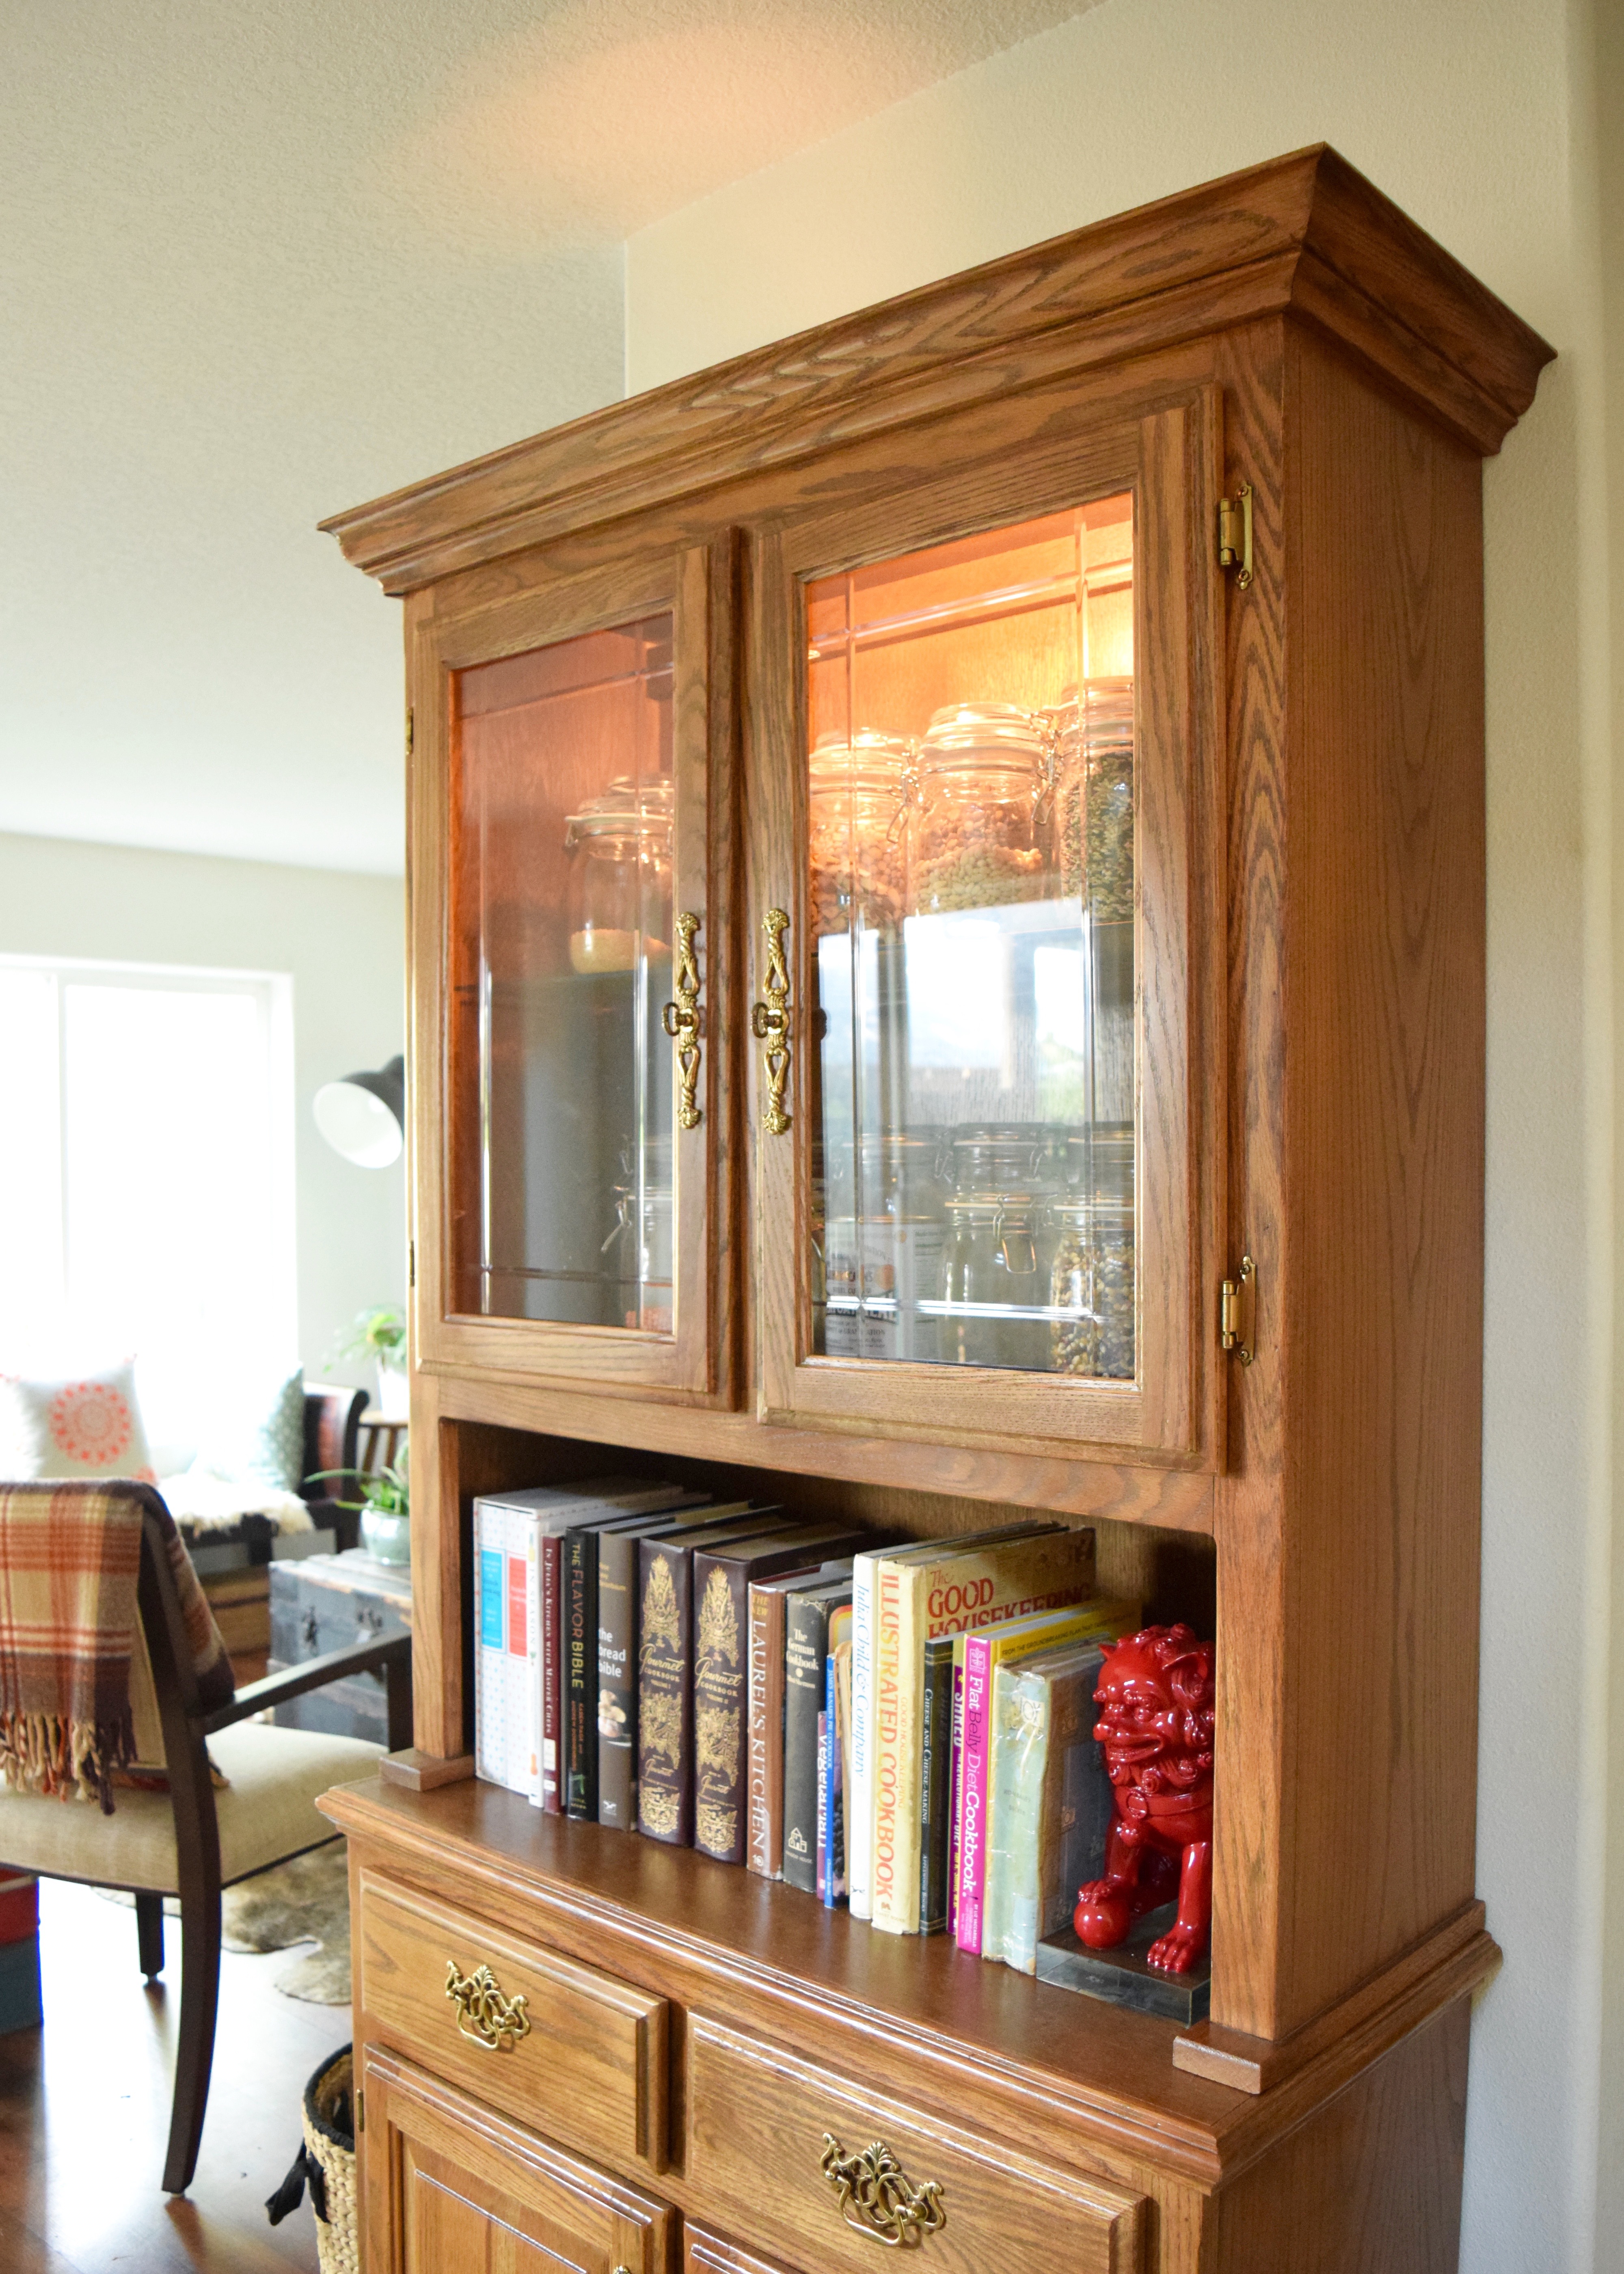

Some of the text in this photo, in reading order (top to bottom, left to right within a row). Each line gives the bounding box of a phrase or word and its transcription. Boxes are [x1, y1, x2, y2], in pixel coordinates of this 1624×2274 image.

[931, 1570, 954, 1587] The
[855, 1582, 870, 1624] Julia
[928, 1578, 994, 1618] GOOD
[929, 1585, 1092, 1639] HOUSEKEEPING
[571, 1543, 584, 1689] THE FLAVOR BIBLE
[598, 1627, 613, 1642] the
[787, 1637, 815, 1656] German
[793, 1628, 808, 1643] The
[856, 1625, 870, 1672] Child
[1002, 1647, 1016, 1656] FROM
[598, 1644, 626, 1662] bread
[598, 1660, 622, 1677] bible
[639, 1643, 686, 1675] Gourmet
[786, 1650, 819, 1671] Cookbook
[644, 1667, 680, 1682] COOKBOOK
[695, 1657, 743, 1689] Gourmet
[700, 1681, 738, 1697] COOKBOOK
[924, 1688, 933, 1726] CHEESE
[969, 1674, 983, 1710] Flat
[752, 1620, 767, 1848] LAUREL'S KITCHEN
[853, 1695, 869, 1777] Company
[876, 1574, 899, 1900] ILLUSTRATED COOKBOOK
[966, 1710, 982, 1753] Belly
[967, 1752, 981, 1791] Diet
